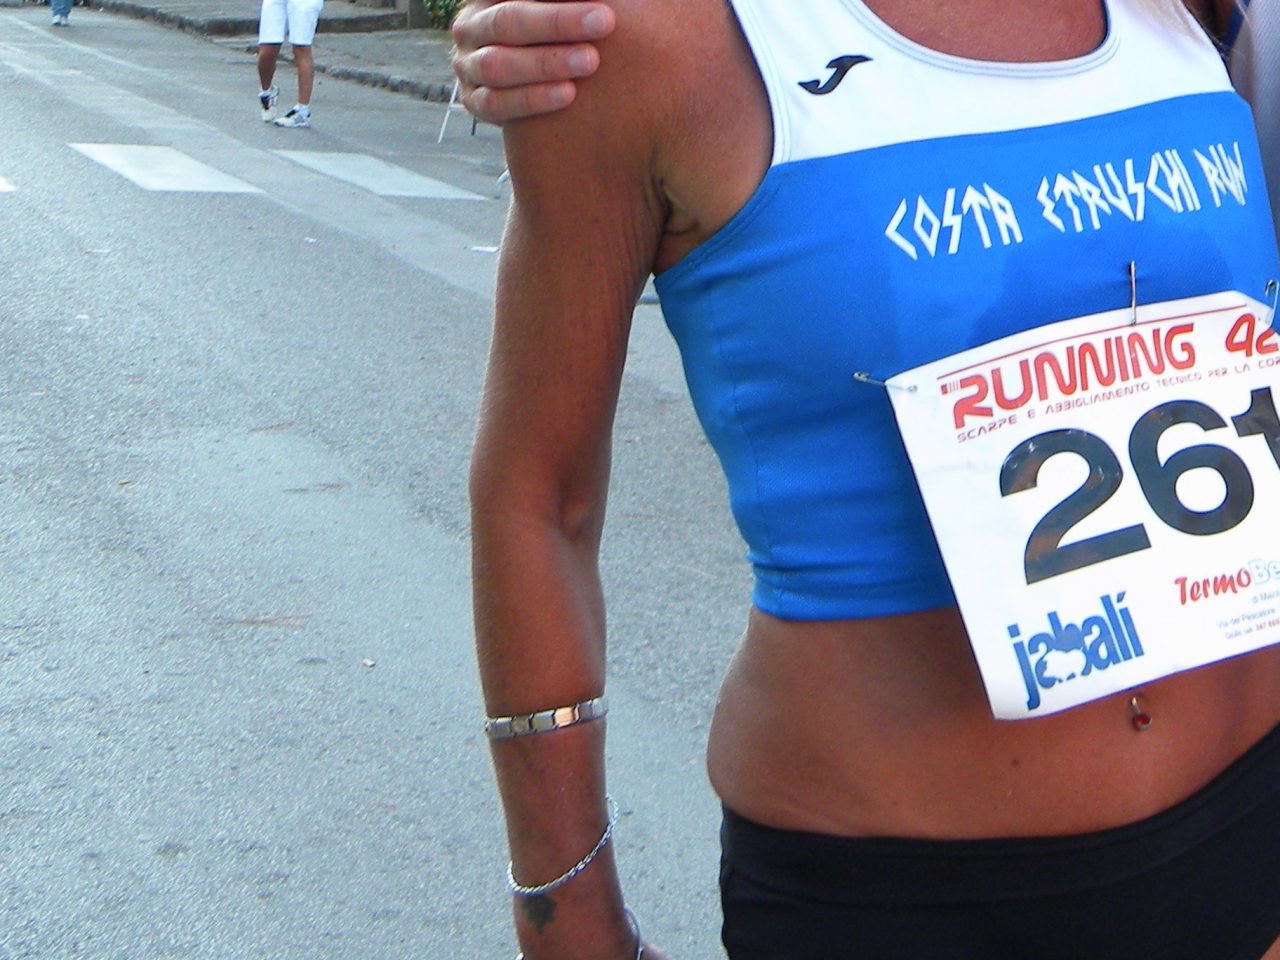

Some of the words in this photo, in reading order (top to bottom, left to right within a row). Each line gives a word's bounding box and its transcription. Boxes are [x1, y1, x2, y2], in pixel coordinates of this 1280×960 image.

[885, 182, 1023, 260] COSTA
[1036, 149, 1201, 233] ETRUSCHI
[1193, 141, 1248, 208] RUN
[941, 323, 1195, 430] RUNNING
[957, 414, 1017, 443] SCARPE
[1028, 408, 1036, 419] E
[1045, 382, 1151, 415] ABBIGLIAMENTO
[1157, 373, 1203, 387] TECNICO
